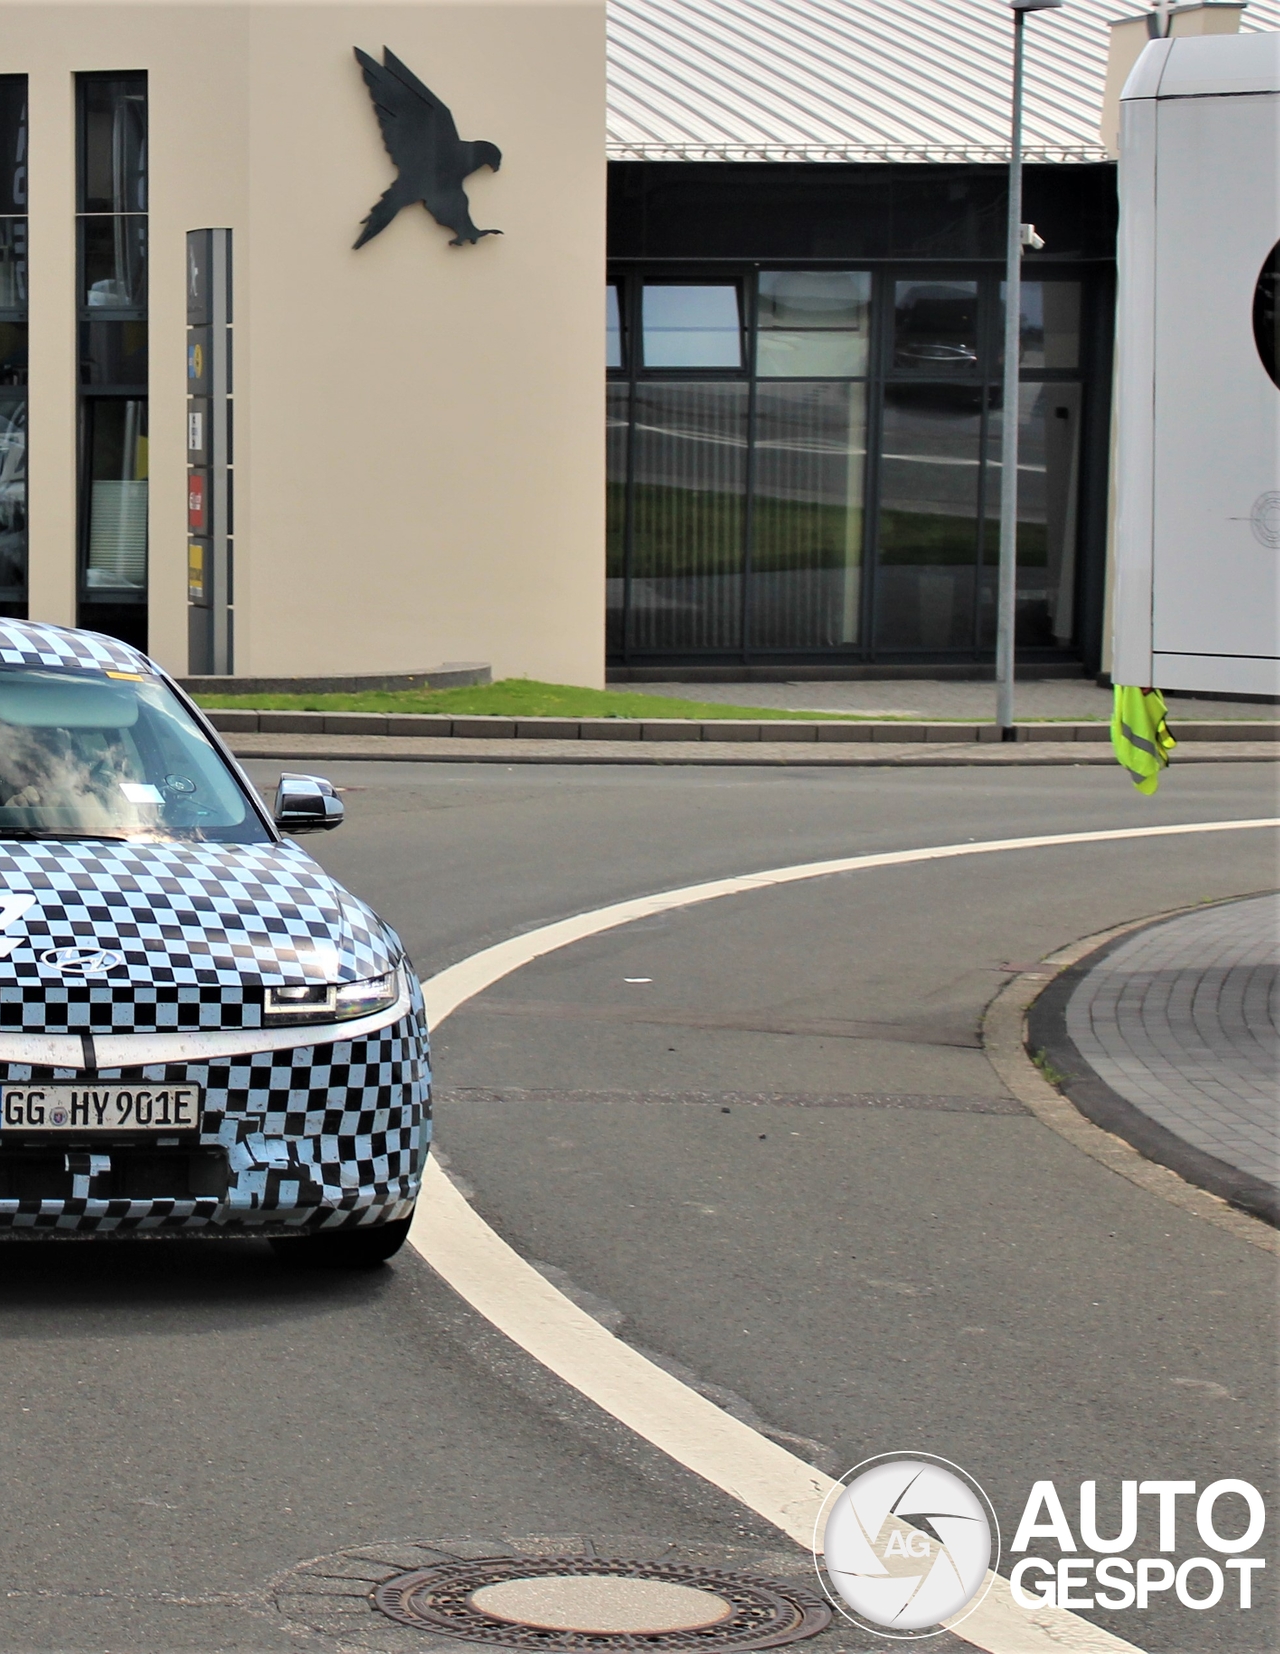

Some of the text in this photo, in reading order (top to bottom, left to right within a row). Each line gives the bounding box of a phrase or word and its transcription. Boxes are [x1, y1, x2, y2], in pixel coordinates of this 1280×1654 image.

[4, 1090, 45, 1125] GG
[71, 1091, 109, 1125] HY
[116, 1090, 192, 1125] 901E
